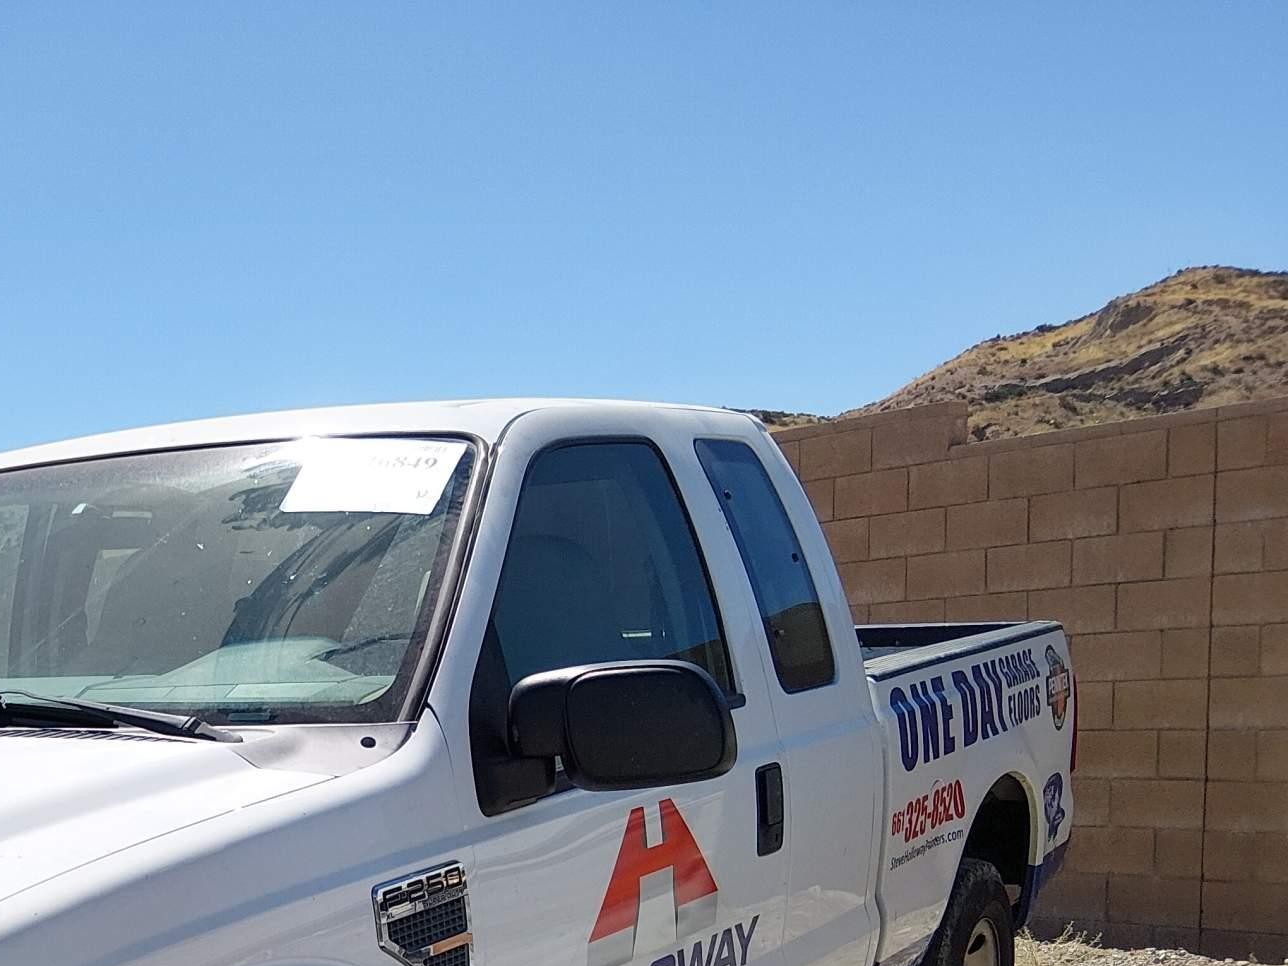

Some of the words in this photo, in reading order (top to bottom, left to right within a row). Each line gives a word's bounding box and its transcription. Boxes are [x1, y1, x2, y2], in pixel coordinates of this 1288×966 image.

[998, 647, 1041, 689] GARAGE
[889, 675, 956, 772] ONE
[952, 656, 1009, 749] DAY
[1007, 687, 1041, 728] FLOORS
[904, 779, 966, 843] 325-8520
